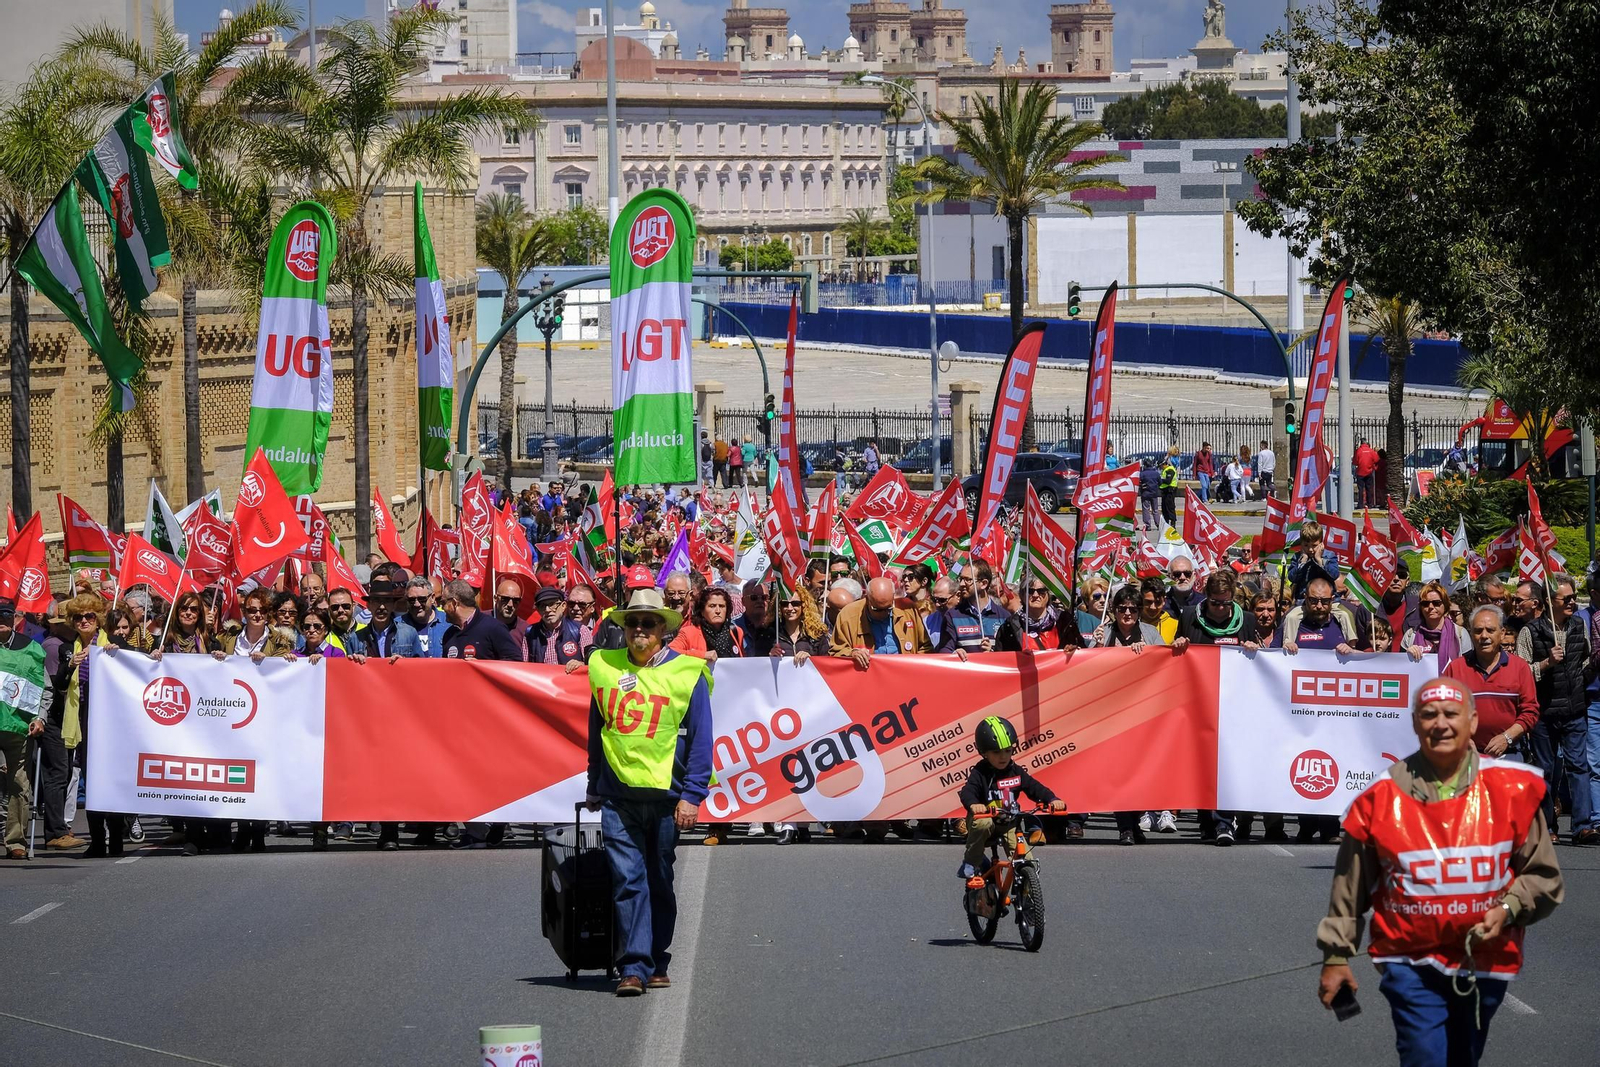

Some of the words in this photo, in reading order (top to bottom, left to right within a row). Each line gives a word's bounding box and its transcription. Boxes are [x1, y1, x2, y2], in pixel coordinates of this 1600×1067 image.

[633, 215, 669, 244] UGT
[1361, 557, 1387, 588] Cádiz
[1297, 676, 1379, 699] CCOO
[197, 696, 246, 709] Andalucía
[197, 705, 227, 718] CÁDIZ
[597, 686, 671, 740] UGT
[1291, 708, 1315, 716] unión
[1317, 709, 1360, 718] provincial
[1375, 710, 1400, 719] Cádiz
[904, 723, 964, 758] Igualdad
[705, 772, 768, 818] de
[780, 697, 919, 795] ganar
[921, 747, 961, 773] Mejor
[1031, 741, 1077, 769] dignas
[142, 759, 226, 784] CCOO
[1298, 757, 1333, 778] UGT
[1345, 770, 1376, 780] Andal
[1345, 779, 1367, 791] CÁD
[137, 790, 162, 799] unión
[163, 793, 207, 802] provincial
[208, 794, 220, 803] de
[221, 795, 247, 804] Cádiz
[1447, 899, 1468, 915] de
